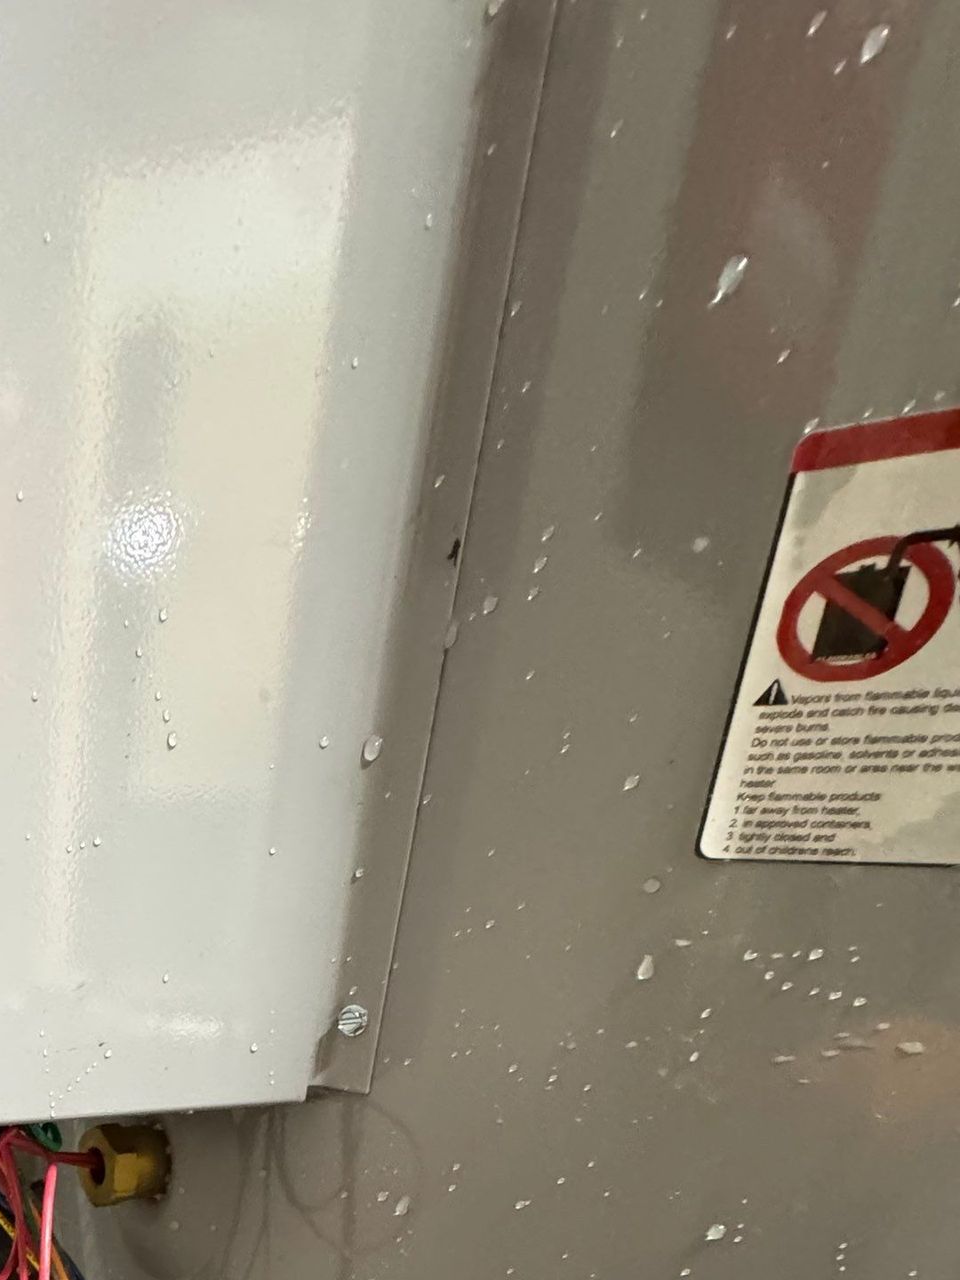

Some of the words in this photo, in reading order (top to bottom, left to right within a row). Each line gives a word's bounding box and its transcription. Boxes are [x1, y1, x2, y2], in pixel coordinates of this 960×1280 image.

[834, 692, 861, 702] from
[864, 690, 930, 701] flammable
[759, 709, 803, 721] explode
[806, 708, 830, 718] and
[831, 707, 864, 717] catch
[867, 705, 887, 716] fire
[889, 705, 939, 716] causing
[755, 725, 793, 734] severe
[751, 737, 767, 748] Do
[770, 738, 789, 747] not
[790, 738, 813, 747] use
[815, 737, 828, 746] or
[830, 736, 860, 745] store
[863, 734, 928, 744] flammable
[748, 752, 775, 761] such
[776, 752, 791, 761] as
[849, 749, 899, 760] solvents
[901, 750, 916, 759] or
[743, 766, 755, 776] in
[756, 765, 775, 775] the
[776, 766, 808, 775] same
[810, 765, 841, 775] room
[844, 765, 857, 774] or
[860, 764, 887, 774] area
[890, 764, 920, 774] near
[922, 763, 943, 773] the
[737, 791, 766, 803] Keep
[767, 791, 827, 801] flammable
[828, 791, 882, 803] products
[743, 805, 759, 815] far
[760, 807, 790, 818] away
[791, 804, 819, 815] from
[755, 820, 809, 830] approved
[738, 831, 772, 844] tightly
[773, 832, 812, 842] closed
[813, 832, 837, 843] and
[735, 846, 754, 855] out
[755, 845, 768, 855] of
